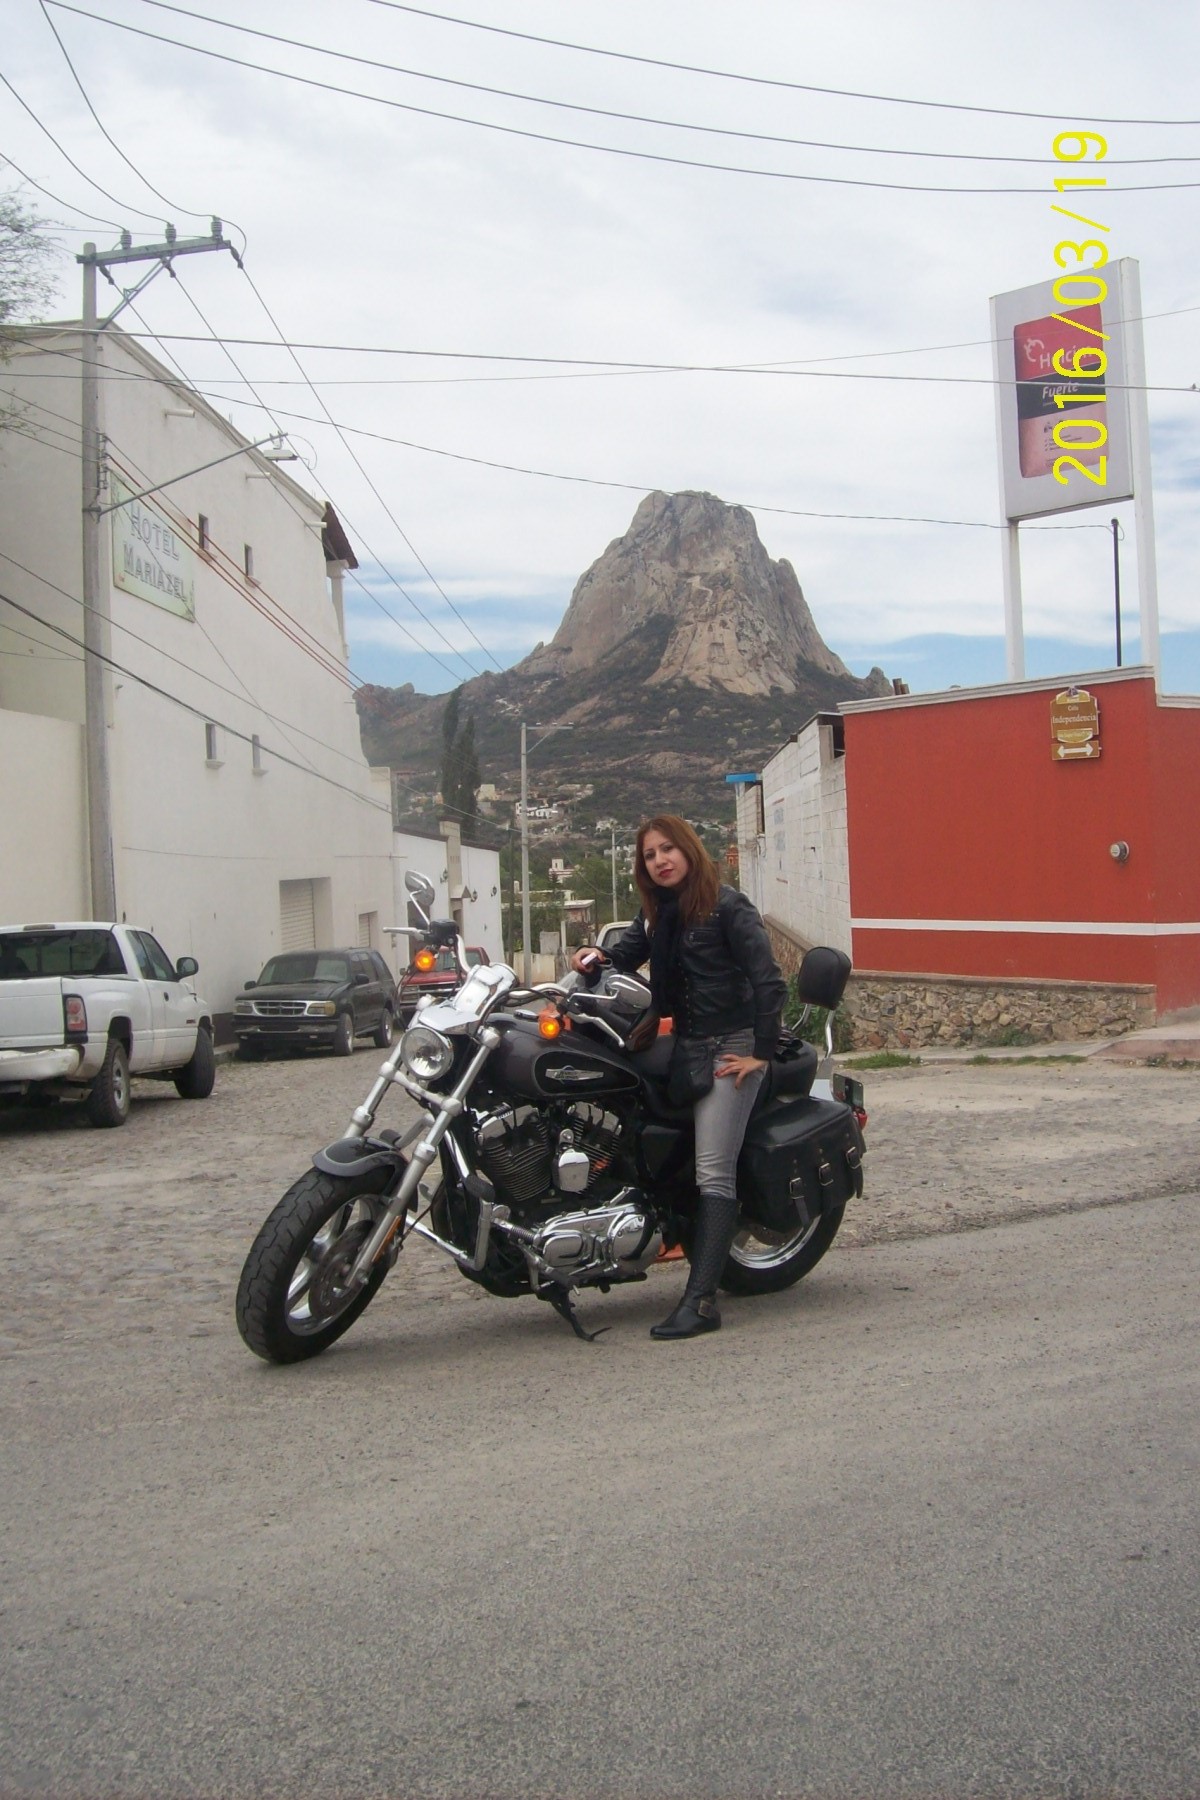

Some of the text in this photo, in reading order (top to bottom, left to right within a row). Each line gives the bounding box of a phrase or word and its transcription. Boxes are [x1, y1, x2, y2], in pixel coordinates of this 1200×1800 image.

[1042, 381, 1079, 399] Fuerte
[130, 499, 180, 562] HOTEL
[1052, 713, 1097, 725] Independencia
